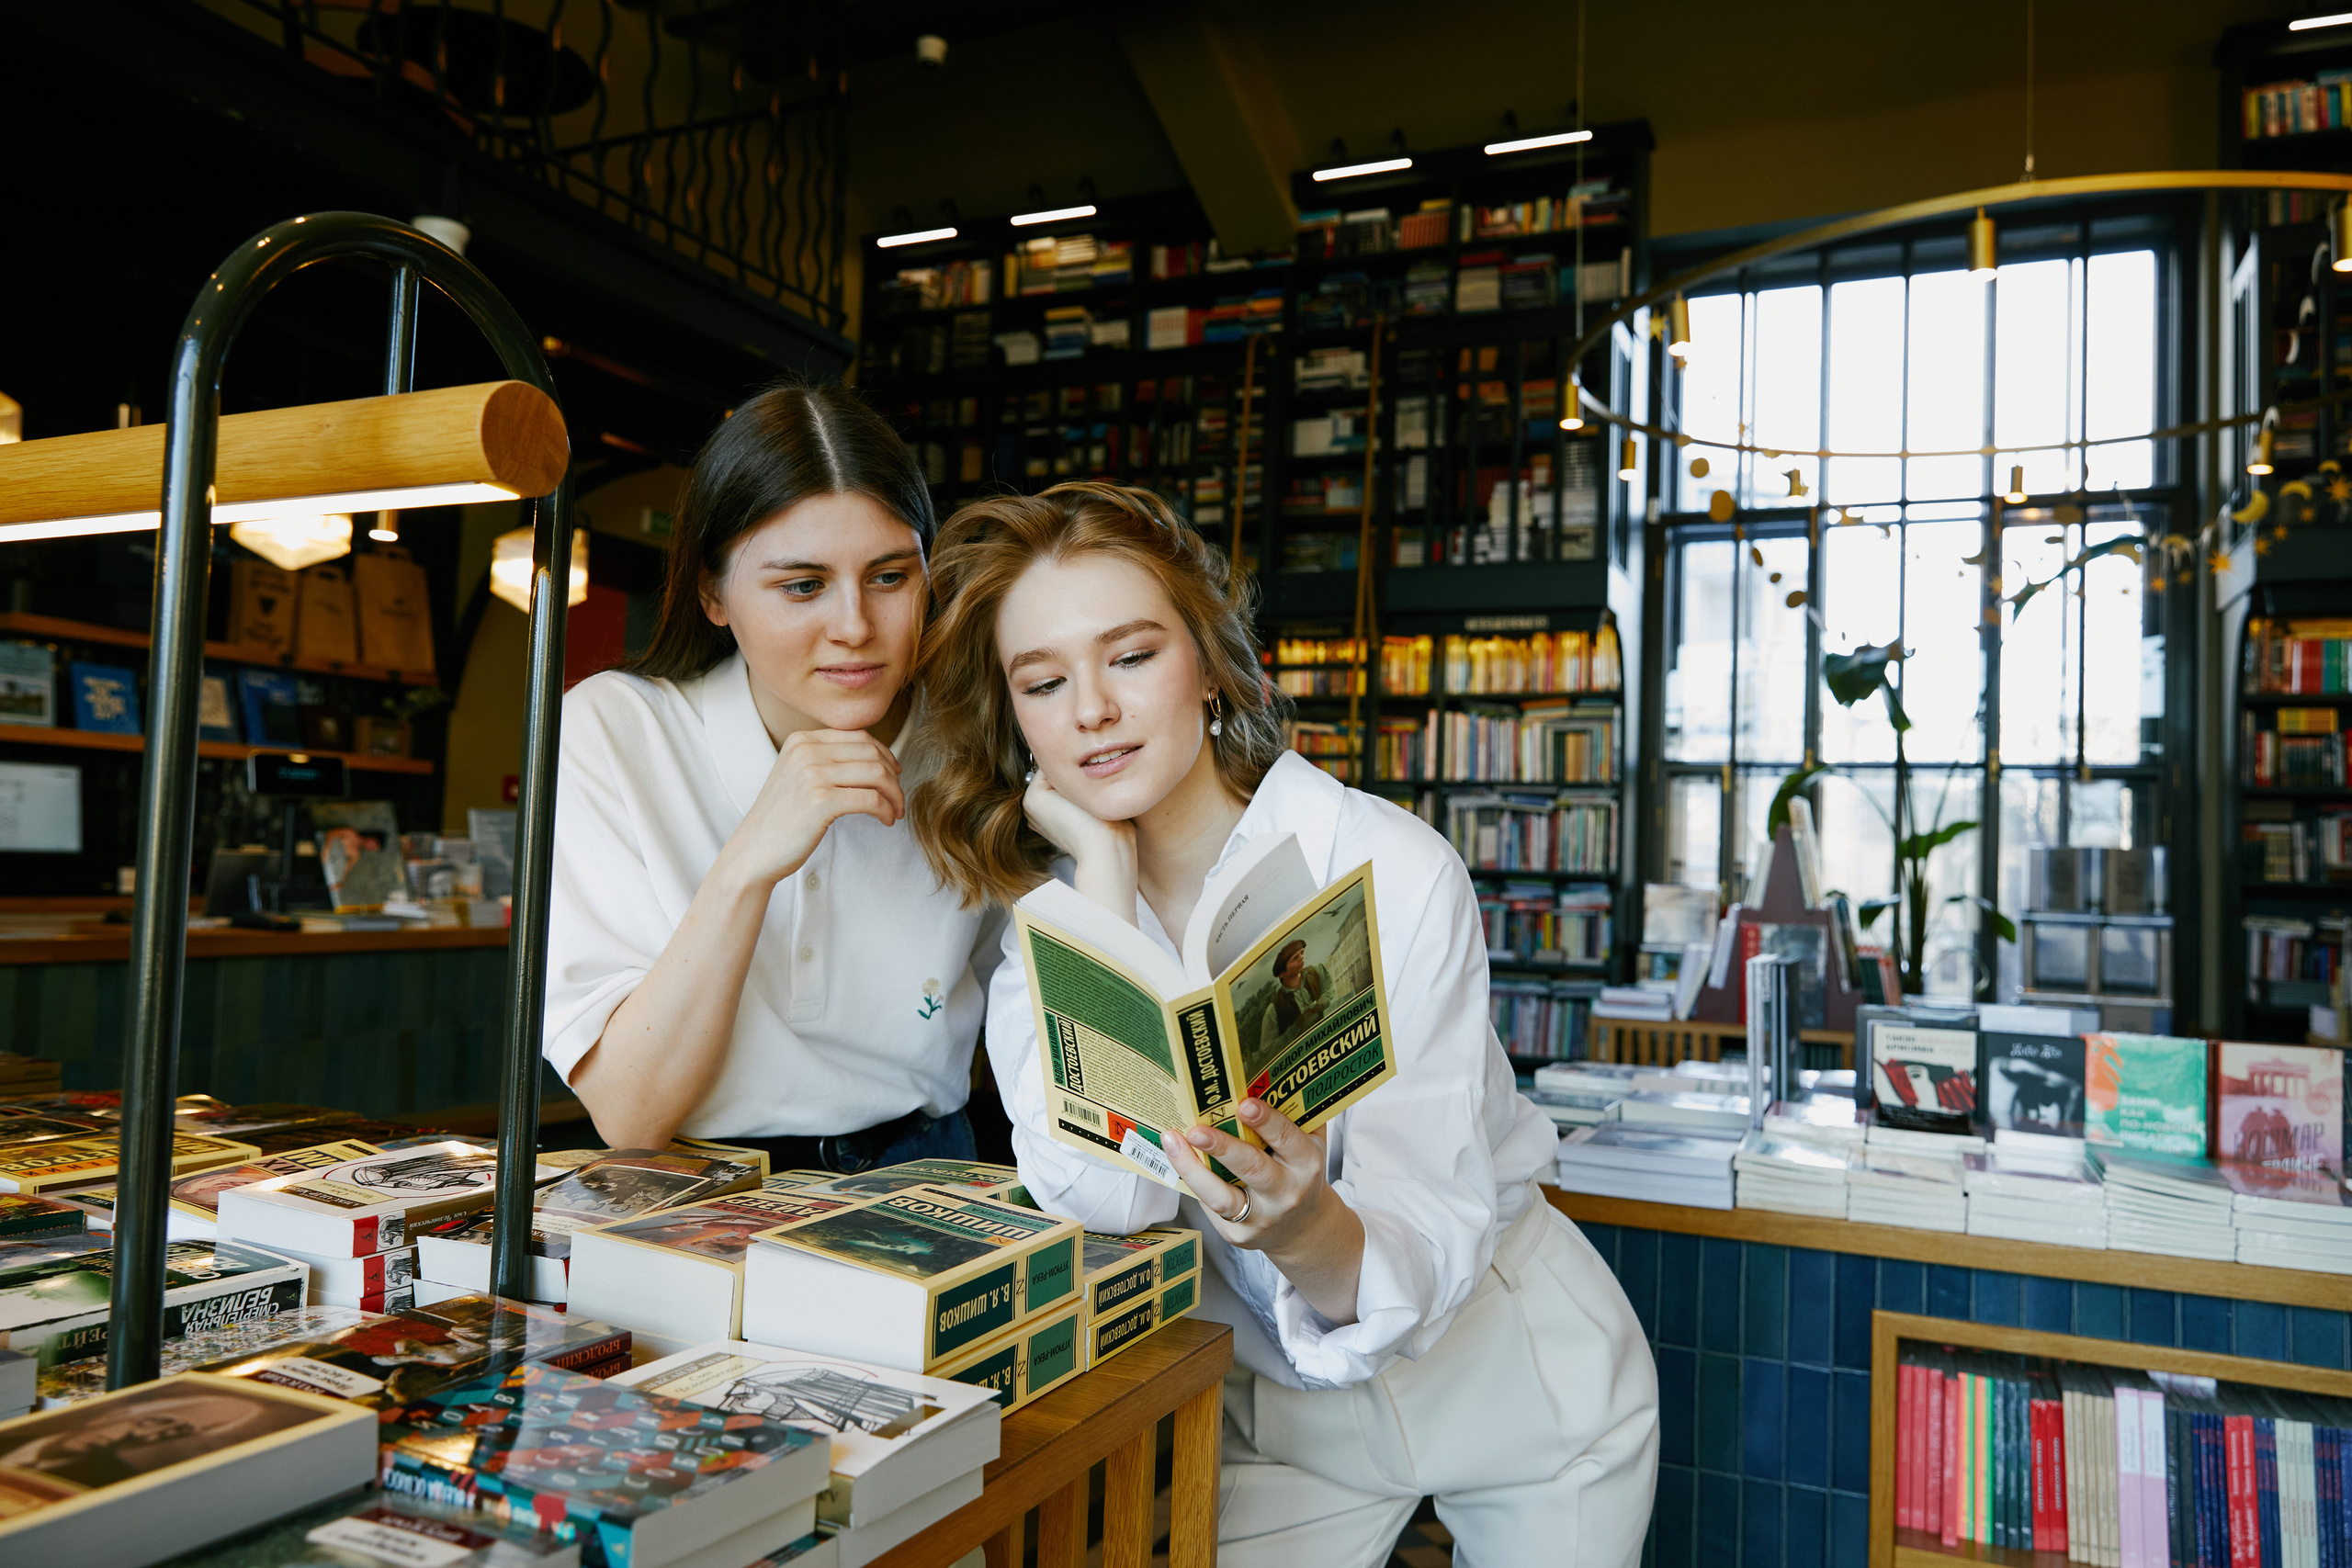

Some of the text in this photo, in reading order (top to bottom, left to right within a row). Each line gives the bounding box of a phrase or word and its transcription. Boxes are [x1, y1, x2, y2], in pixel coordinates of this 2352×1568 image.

[1186, 1009, 1219, 1080] ДОСТОЕВСКИЙ
[1272, 995, 1374, 1077] ФЕДОР МИХАЙЛОВИЧ
[1058, 1019, 1084, 1093] ДОСТОЕВСКИЙ
[1264, 1013, 1377, 1108] ОСТОЕВСКИЙ
[1306, 1043, 1380, 1103] ПОДРОСТОК
[23, 1159, 119, 1176] ГЕНИЙ
[706, 1204, 793, 1221] ЕОДОР
[726, 1198, 826, 1217] АЙЗЕР
[872, 1204, 988, 1239] ВЯЧЕСЛАВ ЯКОВЛЕВИЧ
[888, 1197, 1035, 1240] ШИШКОВ
[971, 1208, 1047, 1230] УГРЮМ-РЕКА
[408, 1214, 452, 1231] Человеческий
[1032, 1260, 1070, 1286] УГРЮМ-РЕКА
[1165, 1247, 1194, 1273] ПОДРОСТОК
[1098, 1272, 1137, 1301] ДОСТОЕВСКИЙ
[1164, 1287, 1193, 1313] ПОДРОСТОК
[181, 1286, 275, 1324] БЕЛИЗНА
[185, 1302, 279, 1334] СМЕРТЕЛЬНАЯ
[939, 1282, 1010, 1332] В. Я. ШИШКОВ
[59, 1327, 109, 1350] РЕЙТ
[1099, 1317, 1137, 1350] ДОСТОЕВСКИЙ
[1034, 1338, 1071, 1367] УГРЮМ-РЕКА
[643, 1365, 698, 1392] ЛЕКСАНДР
[989, 1370, 1000, 1391] Я.
[1000, 1365, 1011, 1385] В.
